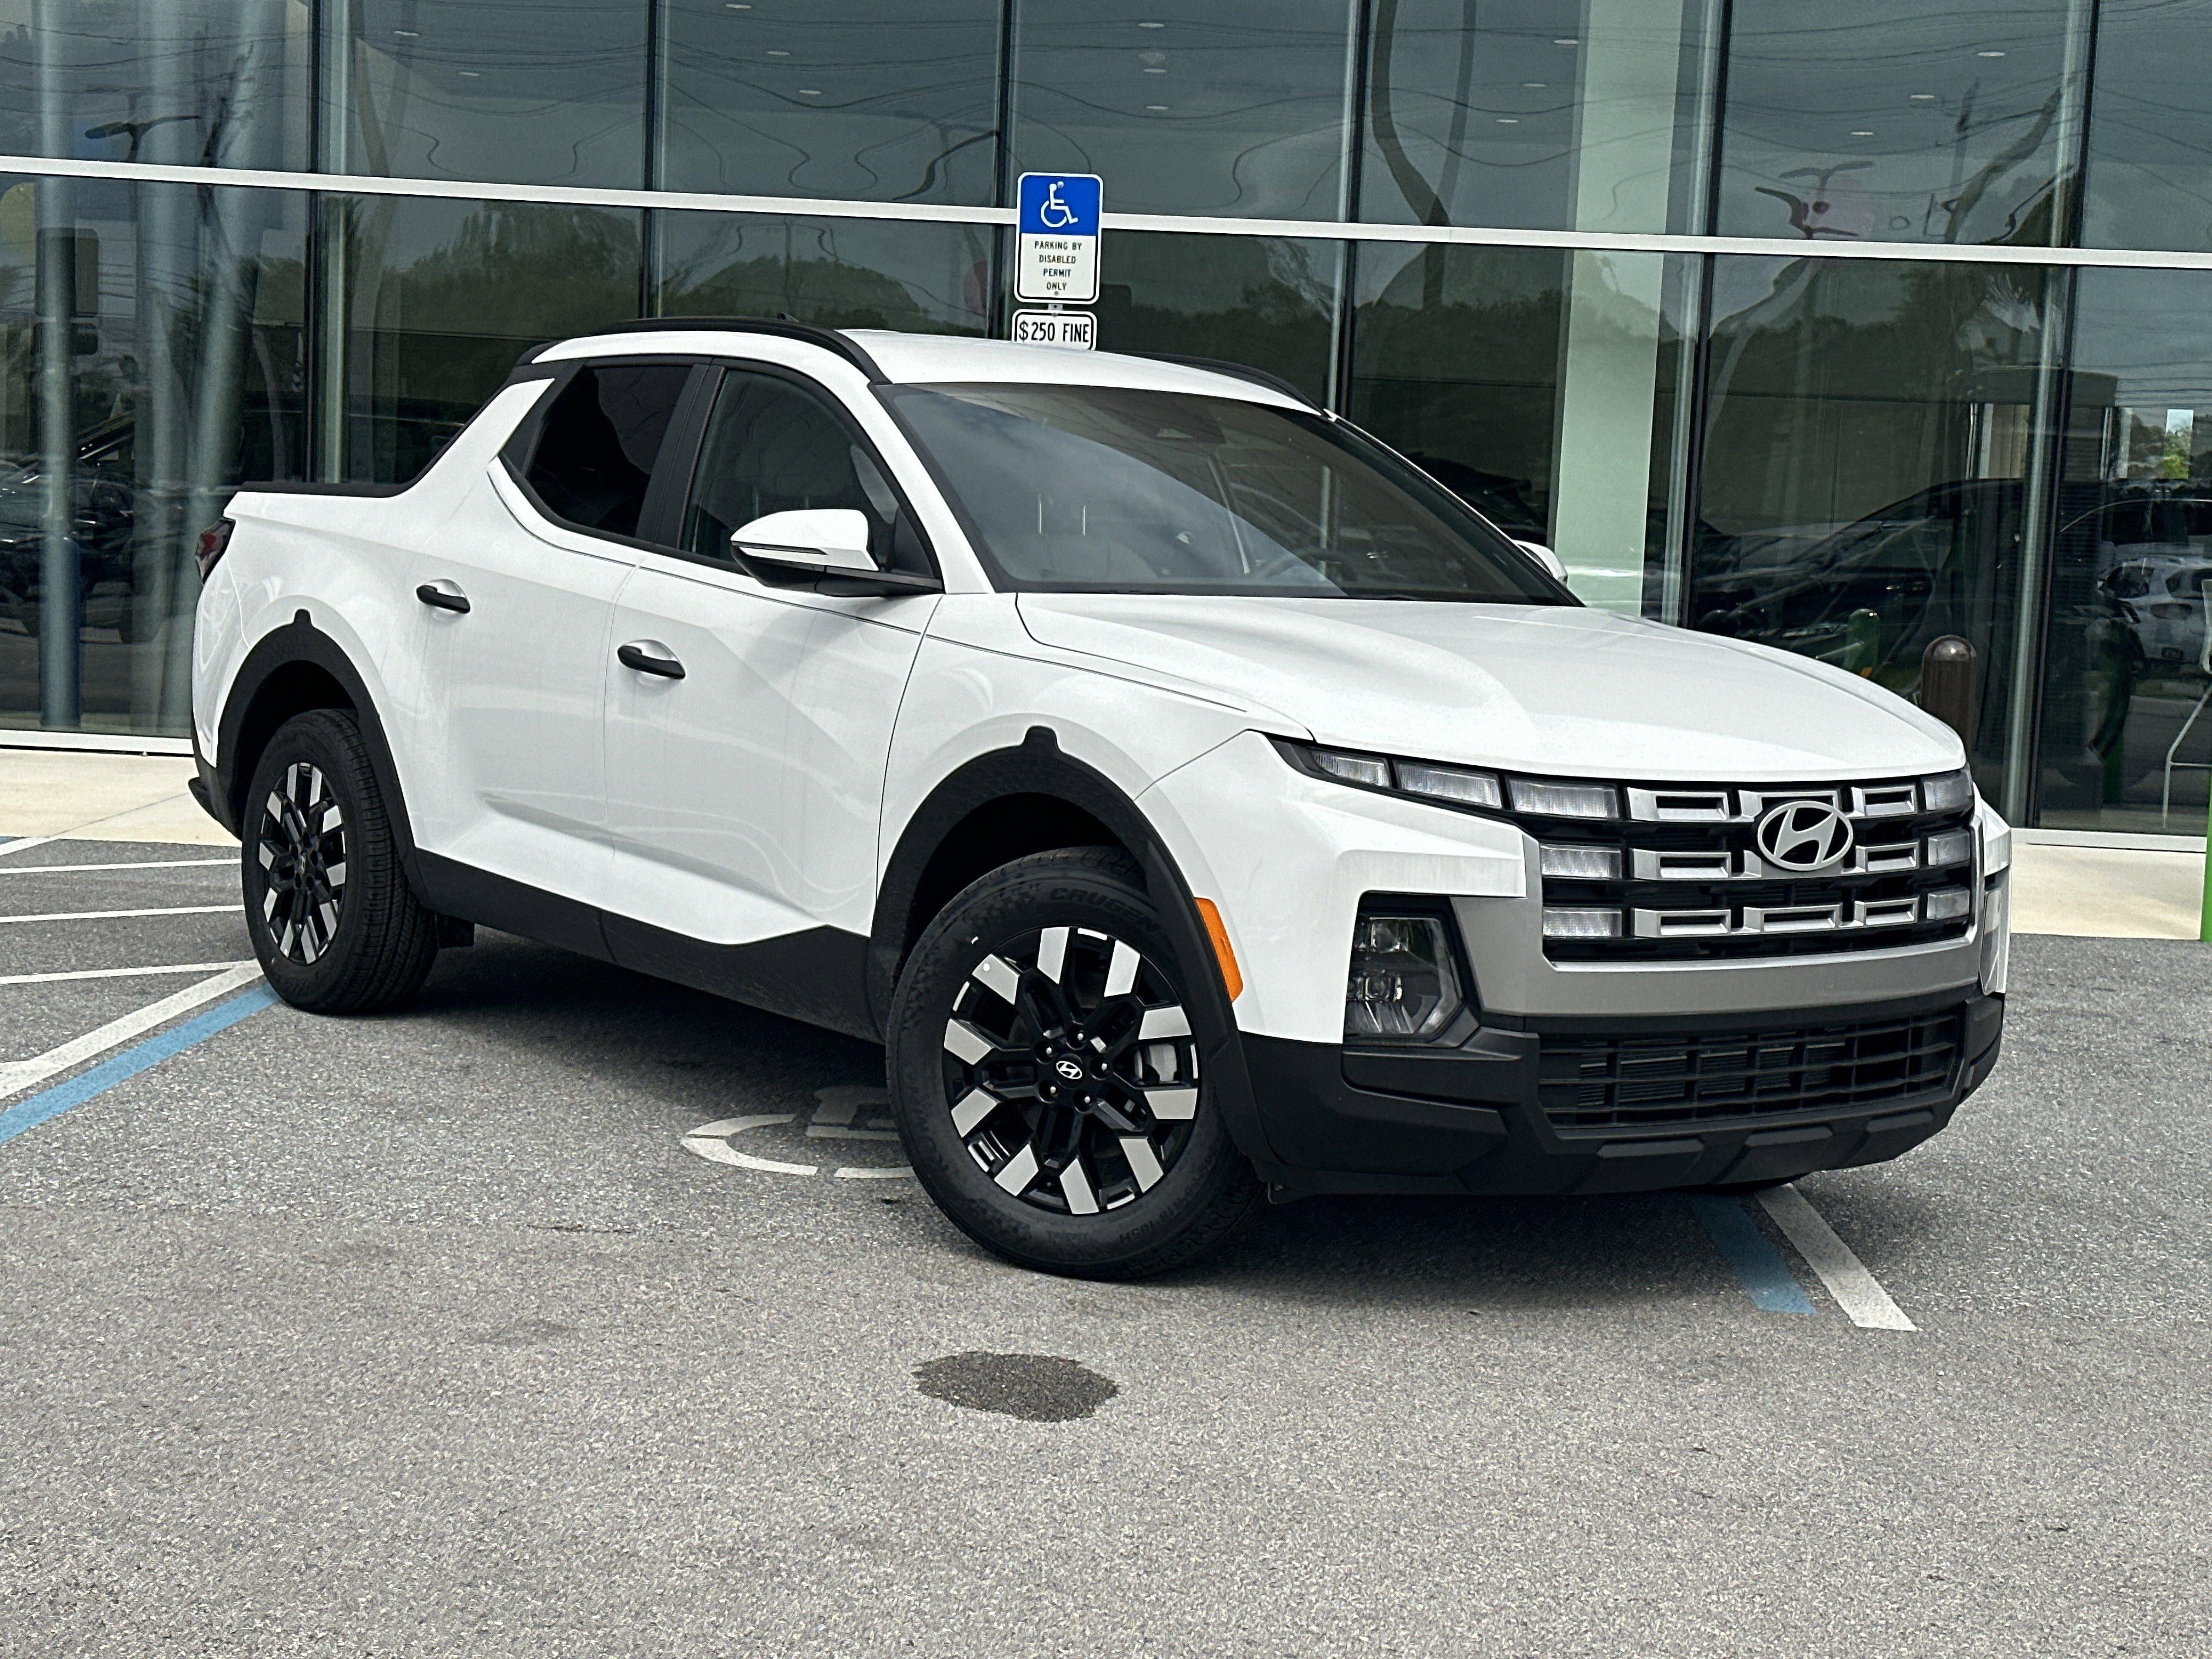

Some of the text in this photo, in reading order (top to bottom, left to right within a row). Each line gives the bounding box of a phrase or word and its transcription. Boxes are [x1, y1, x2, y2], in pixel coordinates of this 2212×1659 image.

[1034, 240, 1082, 250] PARKING BY
[1039, 255, 1076, 264] DISABLED
[1043, 268, 1071, 278] PERMIT
[1046, 282, 1067, 291] ONLY
[1018, 319, 1090, 342] $250 FINE
[1049, 887, 1160, 932] CRUGEN
